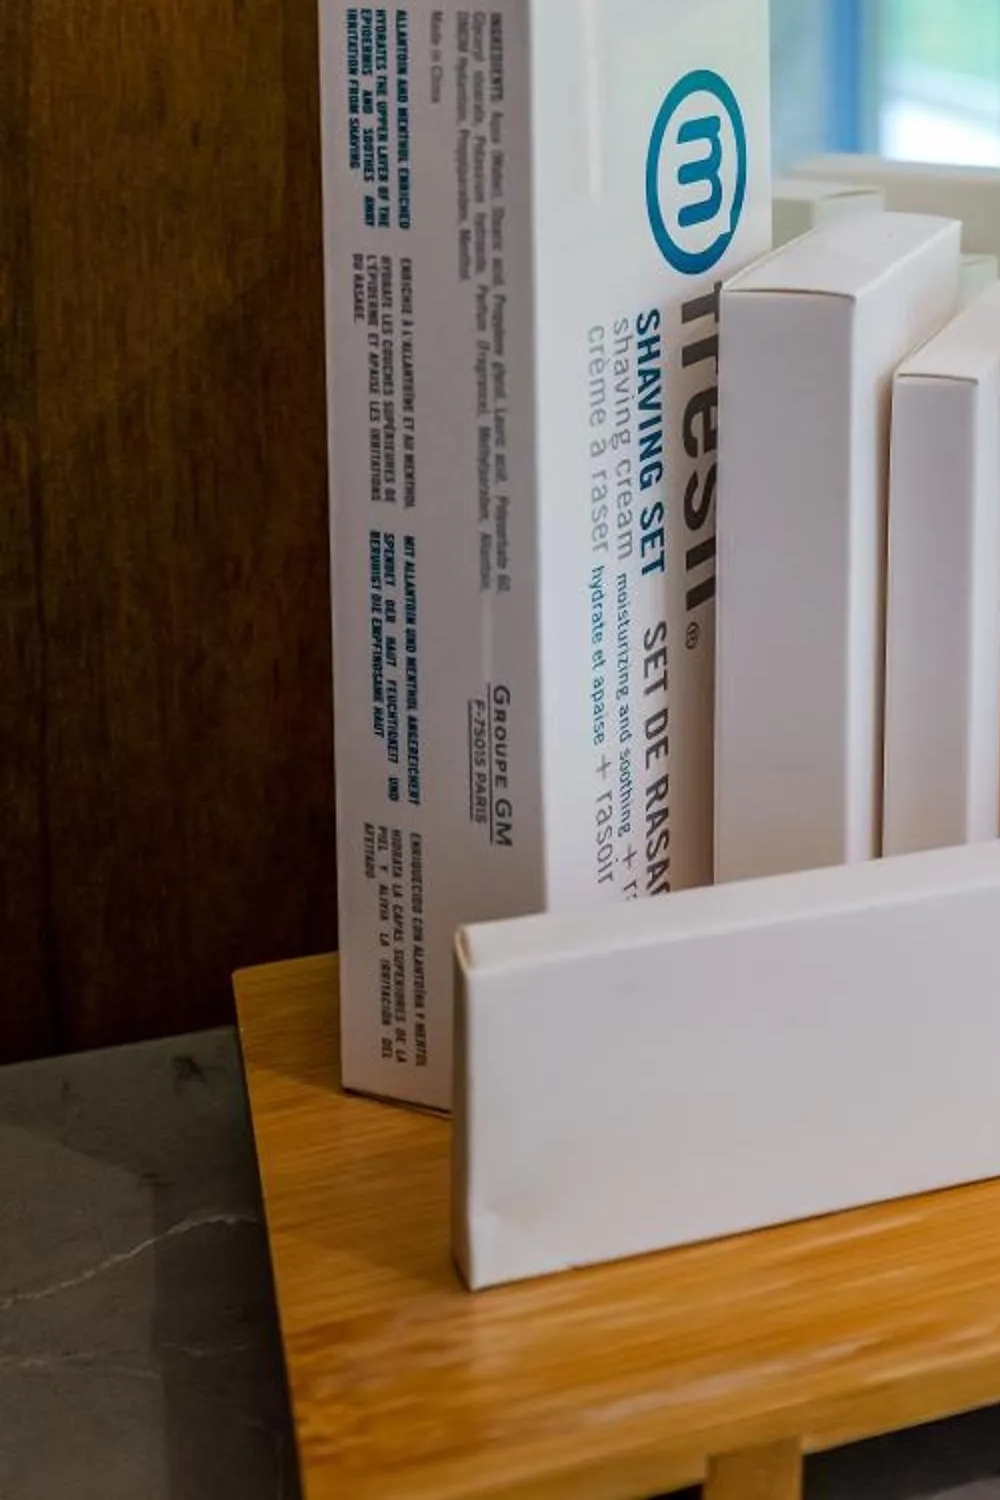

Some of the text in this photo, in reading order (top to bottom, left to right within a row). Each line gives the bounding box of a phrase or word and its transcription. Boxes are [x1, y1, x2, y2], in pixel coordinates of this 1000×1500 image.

[347, 8, 359, 75] IRRITATION
[361, 8, 373, 76] EPIDERMIS
[348, 79, 360, 114] FROM
[362, 90, 374, 115] AND
[376, 9, 390, 228] HYDRATES THE UPPER LAYER OF THE
[396, 9, 411, 229] ALLANTOIN AND MENTHOL ENRICHED
[363, 128, 375, 183] SOOTHES
[588, 325, 610, 428] crème
[610, 318, 634, 450] shaving
[590, 439, 611, 458] à
[636, 308, 665, 576] SHAVING SET
[592, 472, 610, 552] raser
[616, 458, 633, 560] cream
[404, 535, 416, 558] MIT
[385, 599, 396, 623] DER
[404, 560, 417, 625] ALLANTOIN
[589, 565, 605, 644] hydrate
[386, 636, 397, 667] HAUT
[405, 628, 417, 653] UND
[593, 649, 606, 670] et
[616, 573, 633, 700] moisturizing
[643, 621, 668, 694] SET
[406, 656, 418, 711] MENTHOL
[590, 676, 604, 746] apaise
[619, 704, 633, 743] and
[645, 707, 669, 770] DE
[388, 777, 399, 802] UND
[475, 771, 488, 824] PARIS
[618, 748, 634, 837] soothing
[495, 798, 512, 847] GM
[595, 790, 619, 885] rasoir
